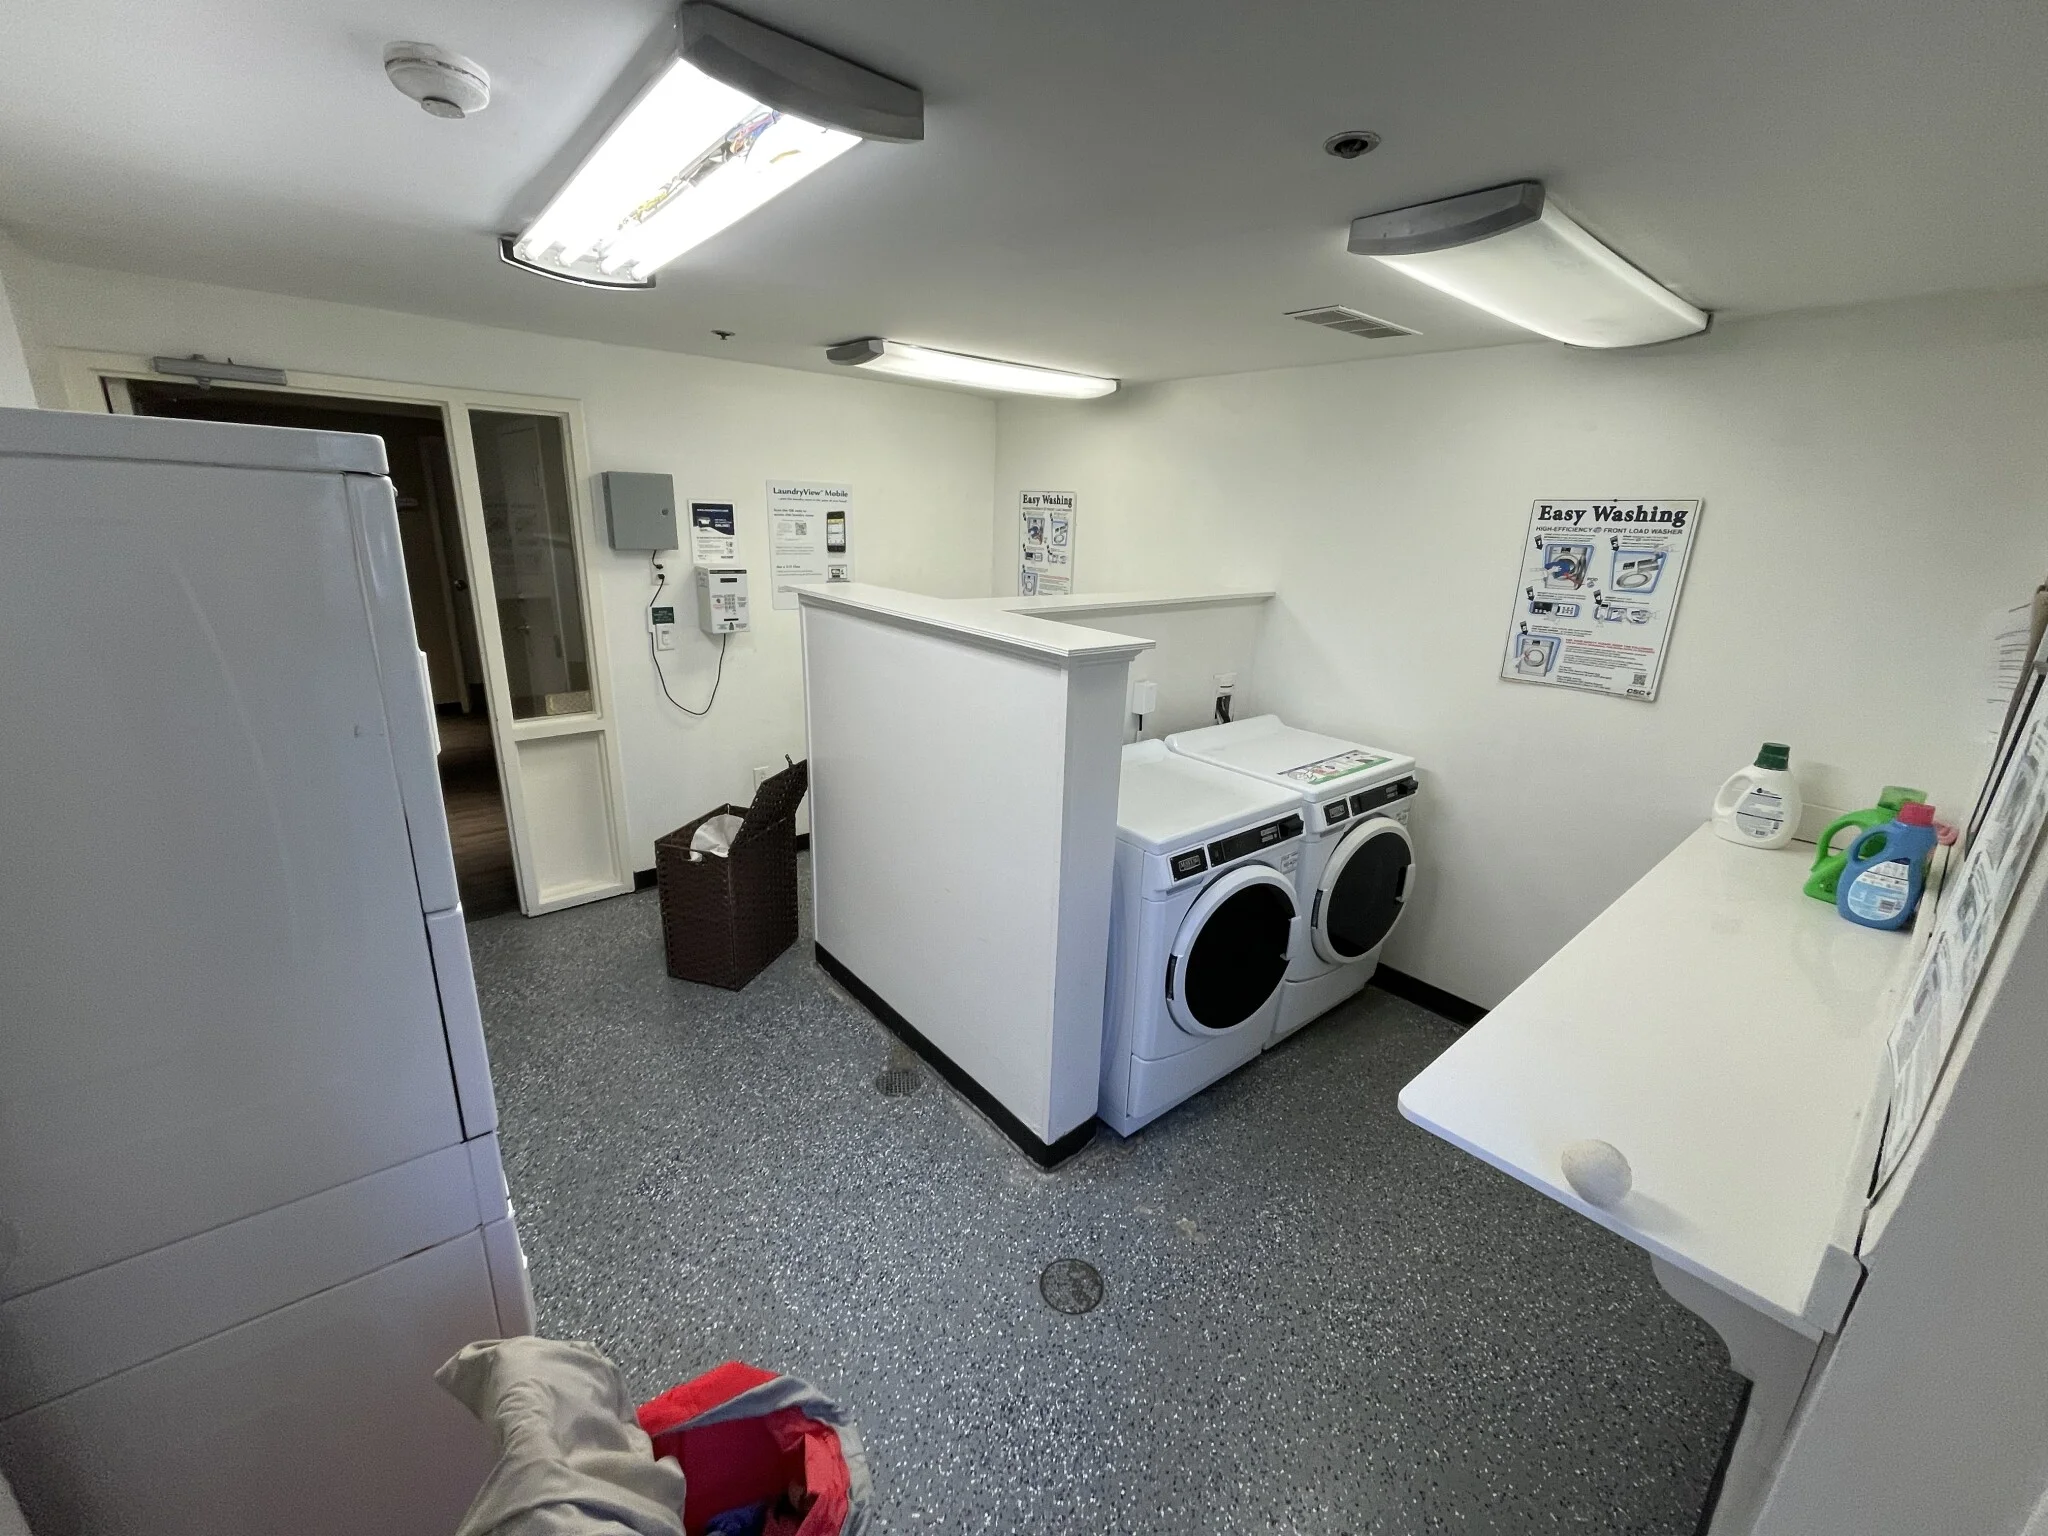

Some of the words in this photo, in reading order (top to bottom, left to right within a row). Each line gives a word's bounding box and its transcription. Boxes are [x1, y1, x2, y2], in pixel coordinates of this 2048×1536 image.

[825, 490, 848, 498] Mobile
[1023, 494, 1040, 506] Easy
[1042, 494, 1072, 508] Washing
[1537, 505, 1587, 525] Easy
[1592, 505, 1688, 527] Washing
[1626, 688, 1646, 696] CSC
